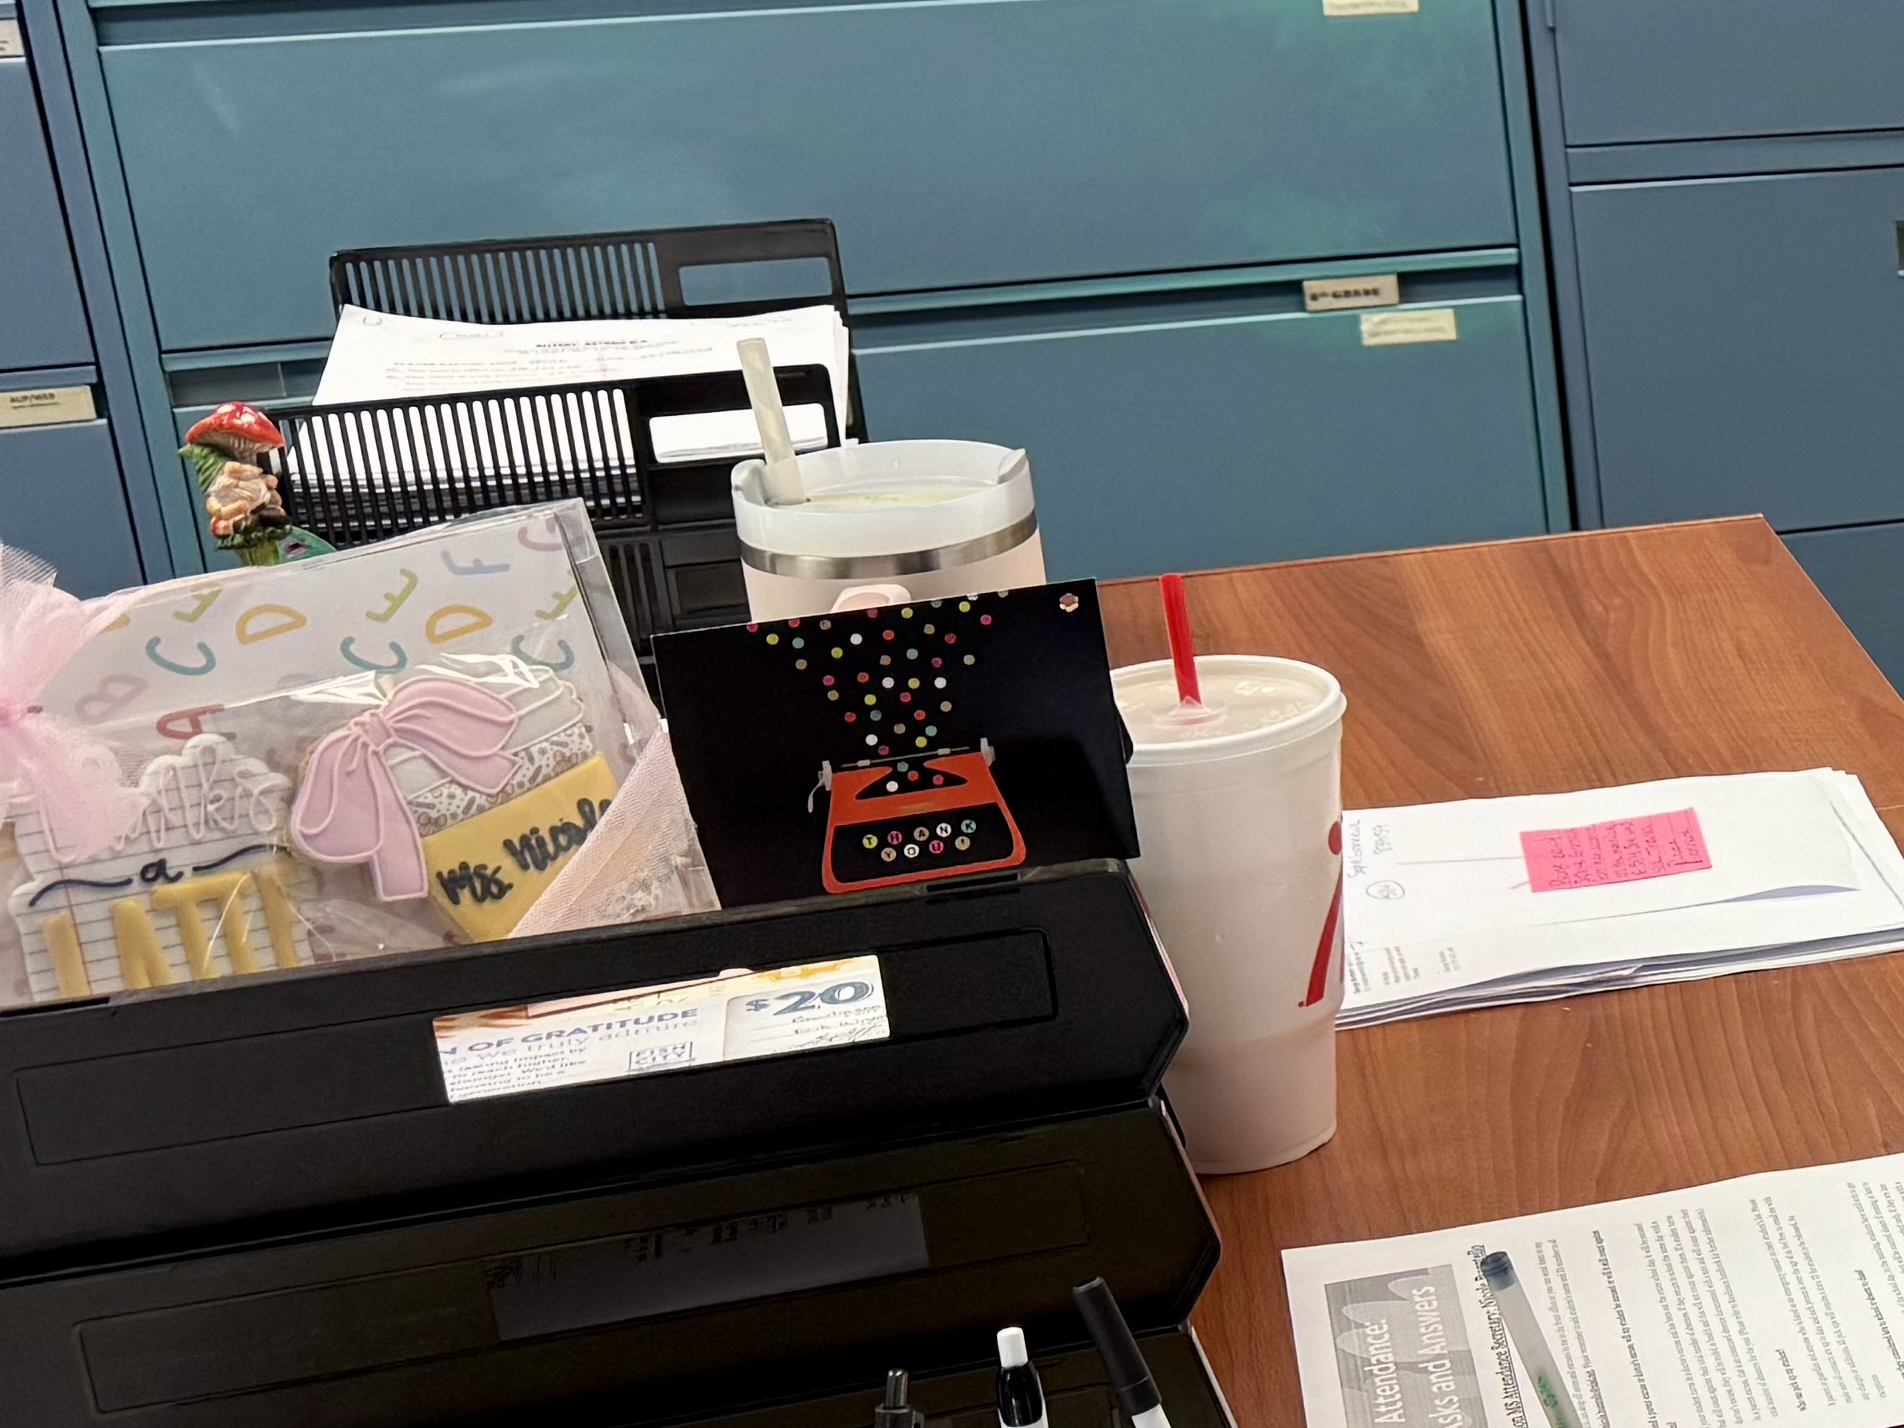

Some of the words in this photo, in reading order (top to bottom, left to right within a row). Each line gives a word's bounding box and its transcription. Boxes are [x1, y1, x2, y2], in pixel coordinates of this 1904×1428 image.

[1331, 287, 1381, 300] GRADE
[865, 819, 973, 847] THANK
[885, 838, 966, 860] YOU!
[745, 980, 874, 1017] $20
[468, 1036, 515, 1052] OF
[521, 1007, 698, 1044] GRATITUDE
[526, 1036, 590, 1053] truly
[598, 1019, 698, 1041] admire
[1409, 1285, 1451, 1356] Answers
[1362, 1317, 1407, 1425] Attendance:
[1418, 1358, 1454, 1394] and
